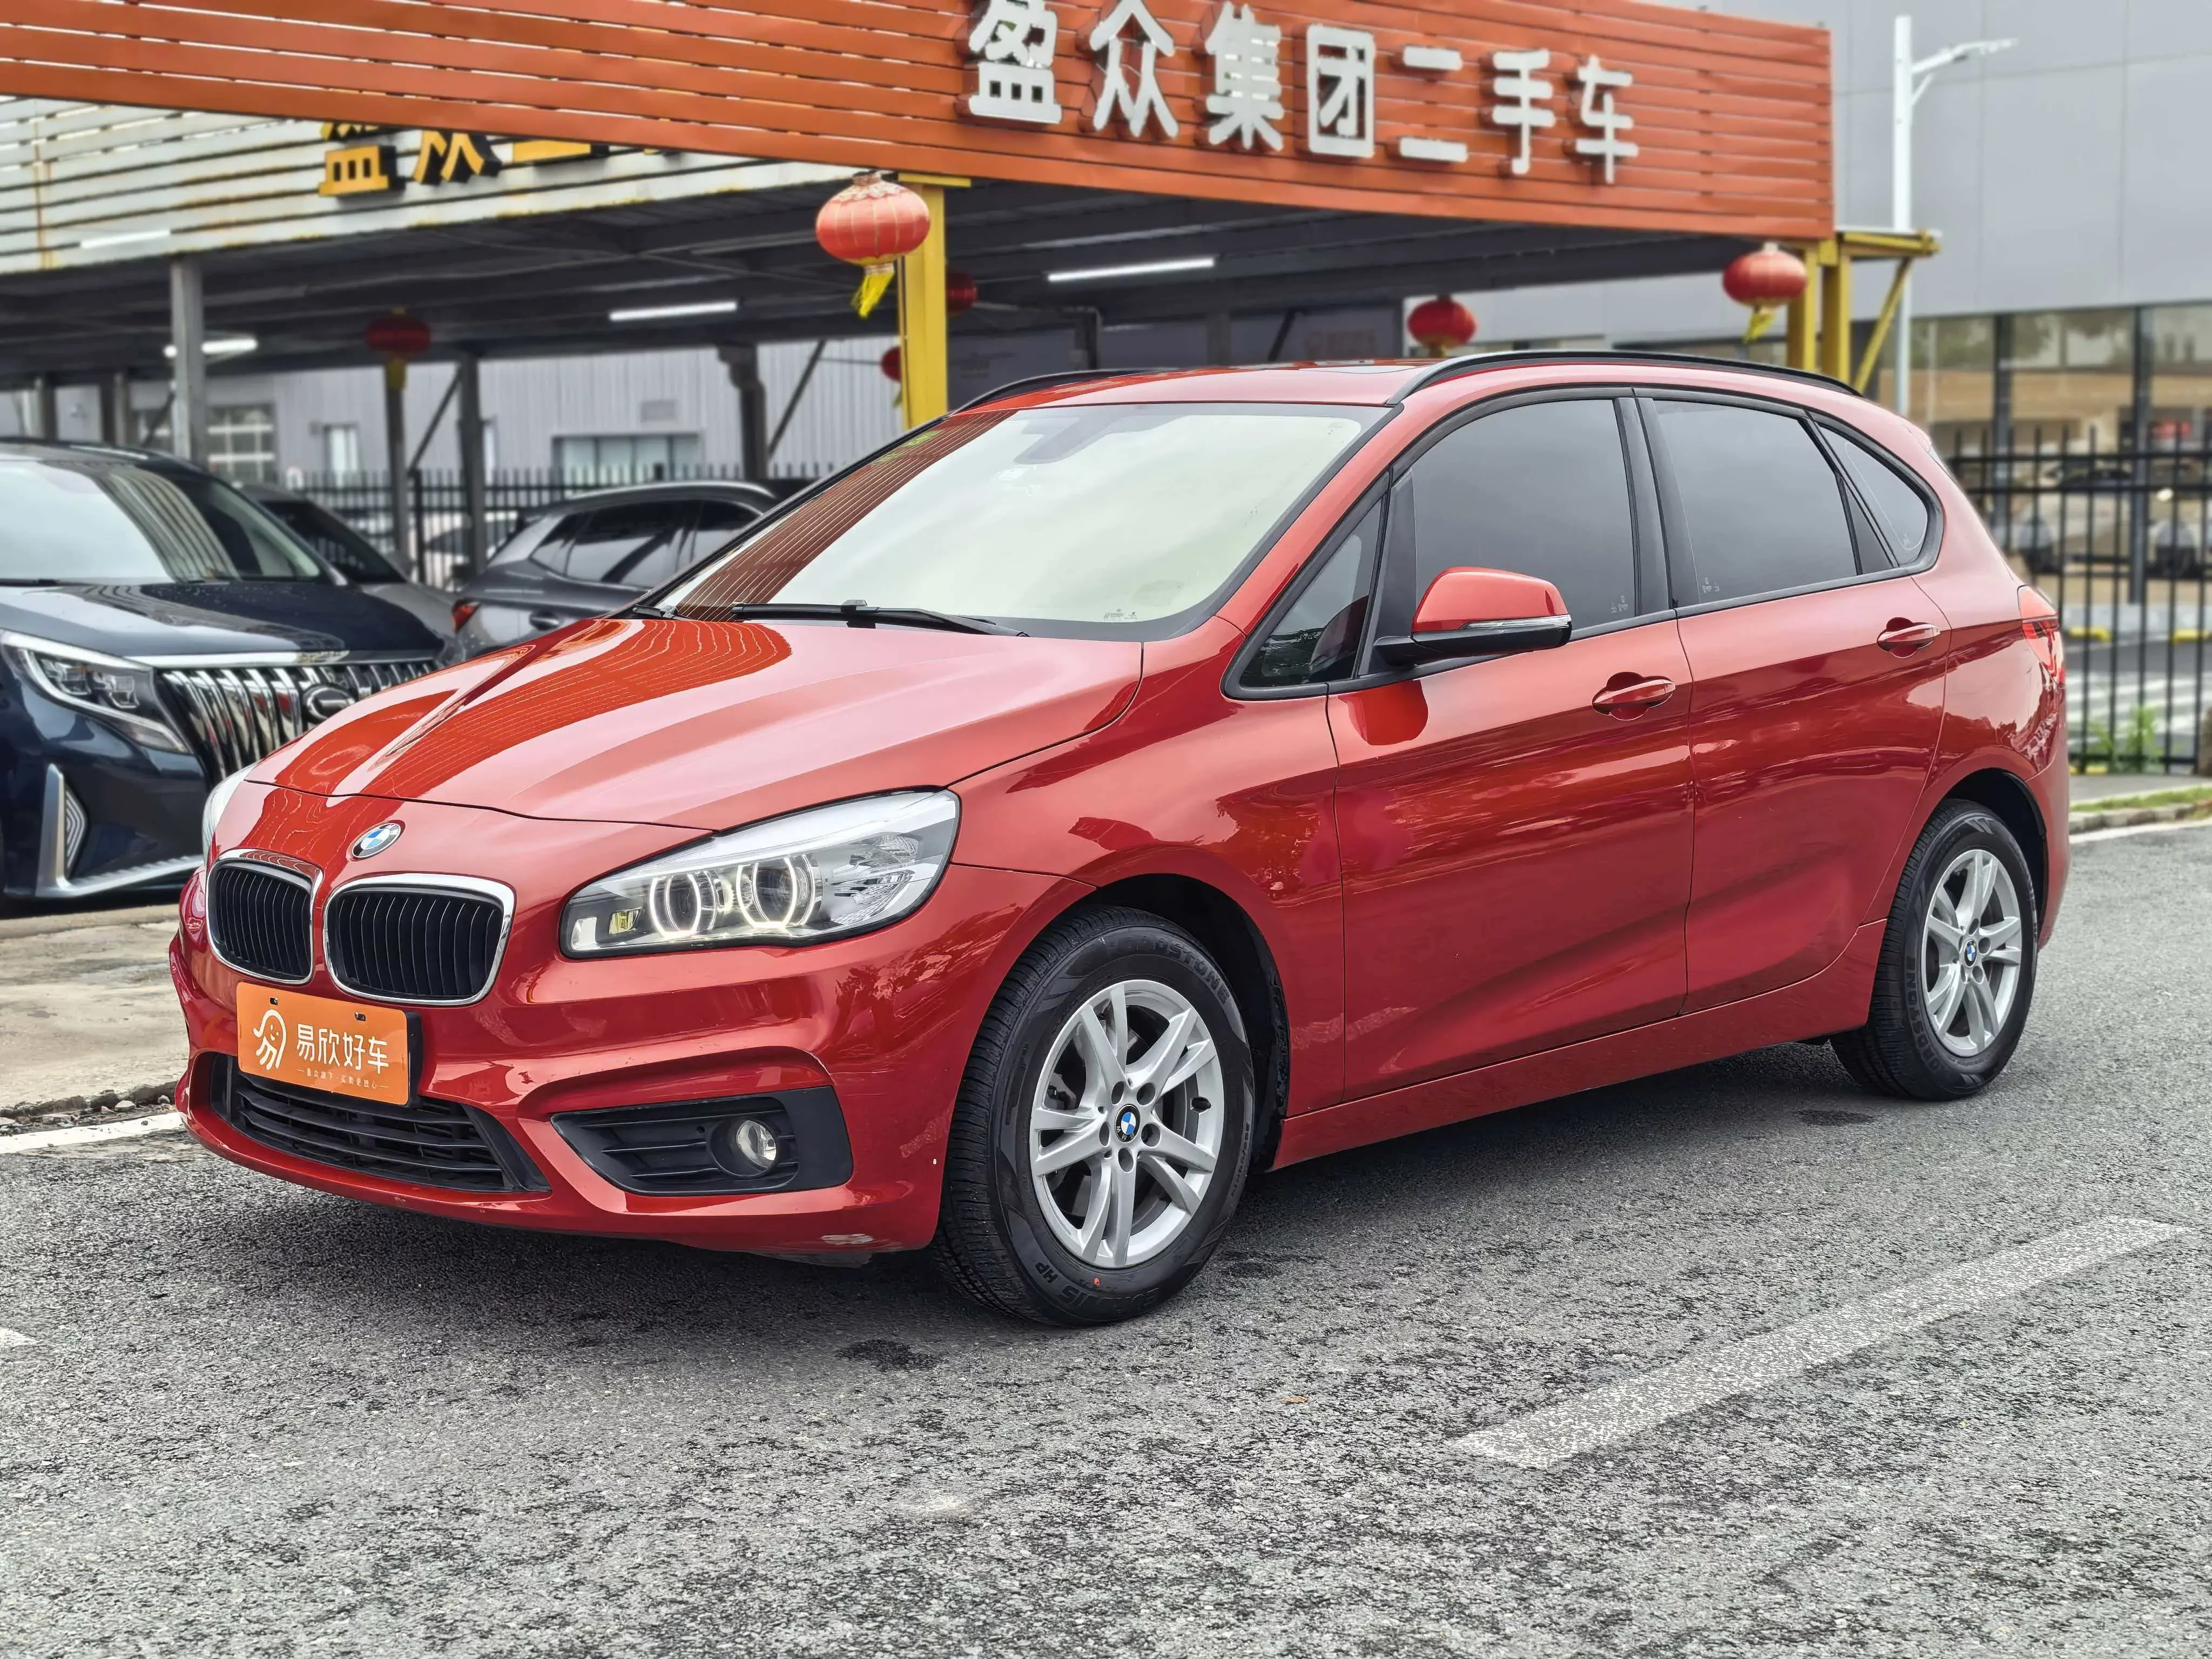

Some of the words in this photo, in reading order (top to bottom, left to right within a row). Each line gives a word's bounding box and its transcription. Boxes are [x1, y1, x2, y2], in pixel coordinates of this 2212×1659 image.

[969, 0, 1638, 183] 盈众集团二手车
[296, 1023, 390, 1075] 易欣好车
